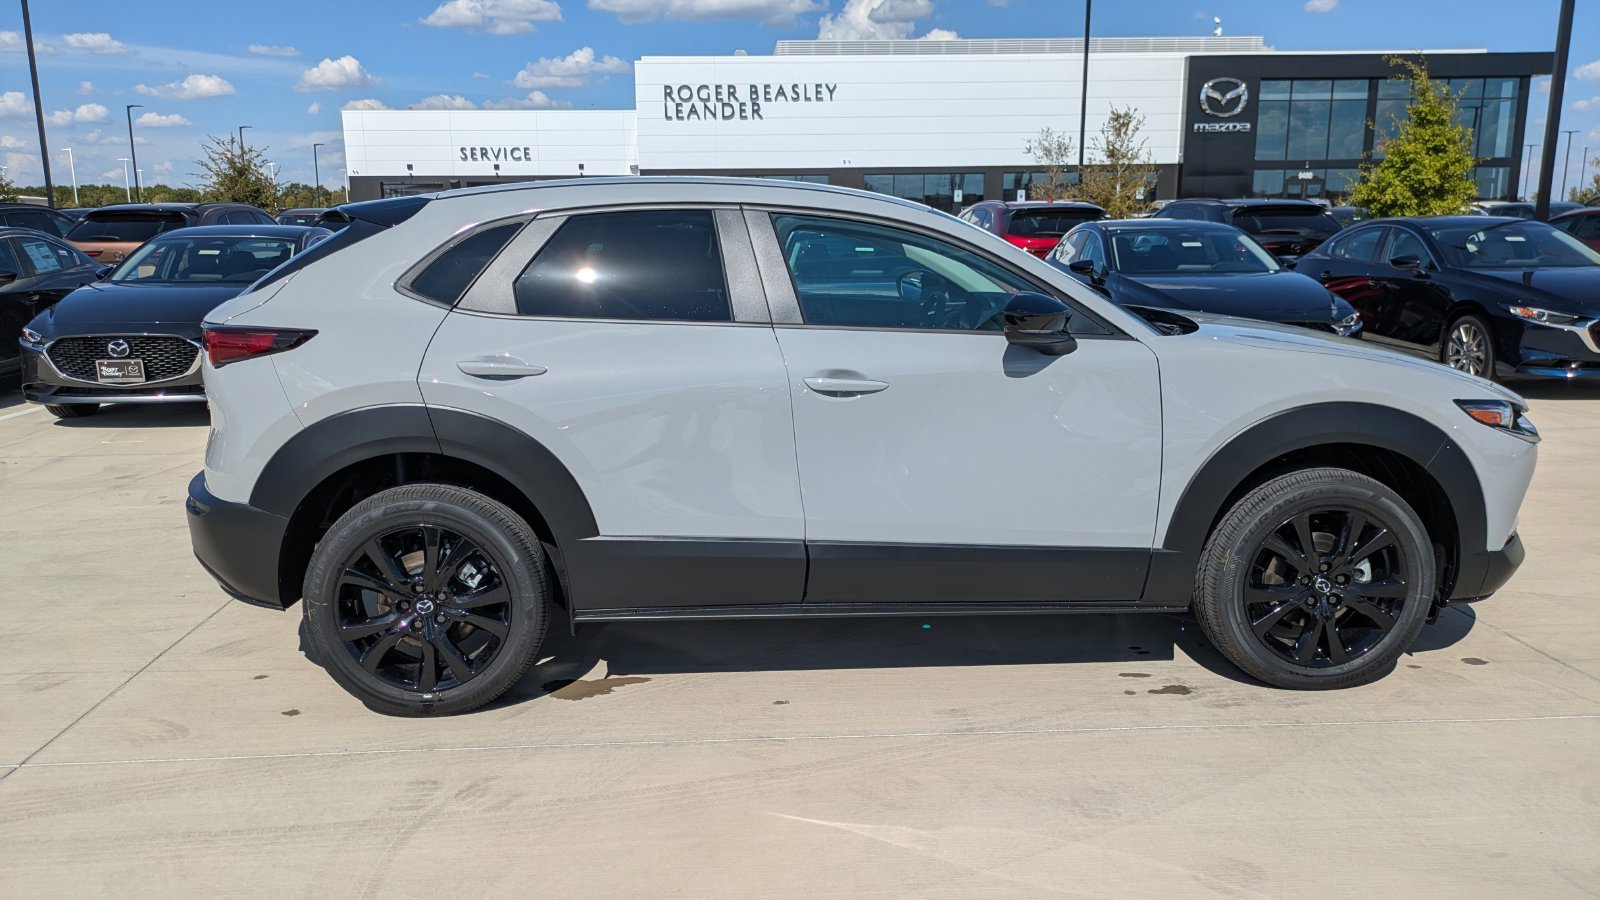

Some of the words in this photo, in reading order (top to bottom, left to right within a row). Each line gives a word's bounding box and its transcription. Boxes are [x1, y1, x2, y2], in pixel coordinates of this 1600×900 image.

[664, 84, 739, 103] ROGER
[750, 83, 837, 102] BEASLEY
[664, 102, 763, 120] LEANDER
[459, 147, 531, 161] SERVICE
